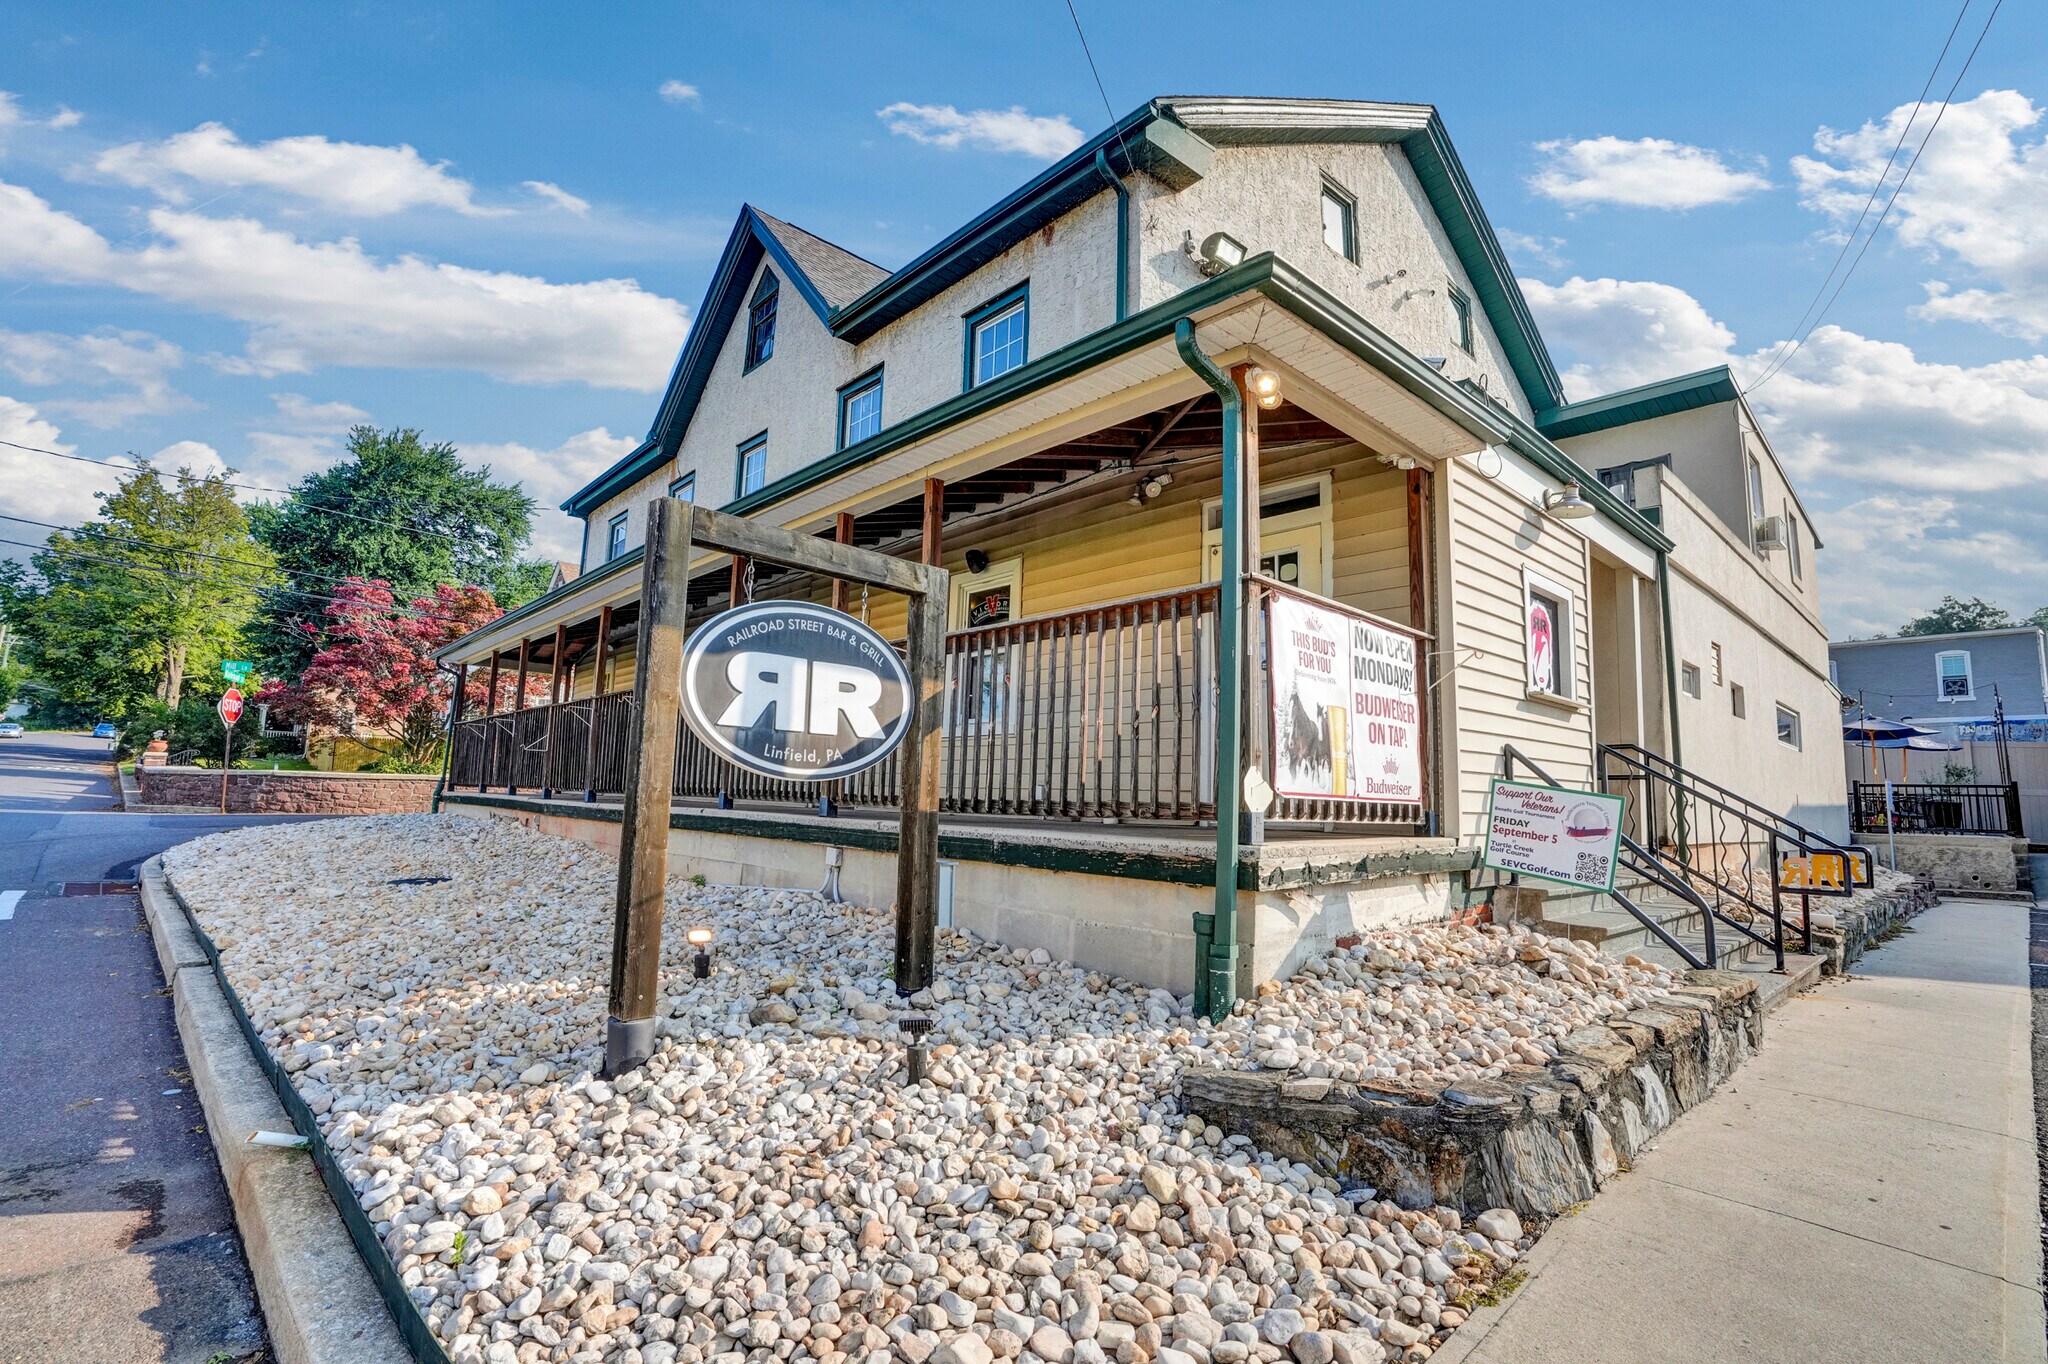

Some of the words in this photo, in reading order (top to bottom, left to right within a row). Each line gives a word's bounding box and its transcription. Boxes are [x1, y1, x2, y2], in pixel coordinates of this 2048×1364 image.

[973, 600, 1009, 616] VICTOR
[727, 618, 784, 647] RAILROAD
[788, 618, 824, 634] STREET
[827, 625, 846, 641] BAR
[849, 635, 857, 647] &
[859, 641, 885, 668] GRILL
[1291, 630, 1311, 650] THIS
[1312, 636, 1336, 658] BUD'S
[1354, 625, 1384, 655] NOW
[1385, 635, 1413, 665] OPEN
[1298, 650, 1315, 670] FOR
[1316, 655, 1331, 674] YOU
[1354, 655, 1413, 692] MONDAYS!
[224, 698, 242, 713] STOP
[1355, 692, 1416, 725] BUDWEISER
[1368, 722, 1386, 746] ON
[1388, 724, 1408, 749] TAP!
[764, 743, 821, 765] Linfield,
[827, 748, 843, 761] PA
[1366, 777, 1412, 796] Budweiser
[1496, 786, 1533, 799] Support
[1534, 791, 1554, 803] Our
[1521, 799, 1566, 815] Veterans!
[1525, 811, 1556, 820] Tournament
[1494, 816, 1530, 828] FRIDAY
[1492, 824, 1549, 842] September
[1551, 834, 1558, 844] 5
[1491, 840, 1512, 849] Turtle
[1513, 844, 1534, 853] Creek
[1506, 849, 1530, 858] Course
[1500, 858, 1571, 879] SEVCGolf.com
